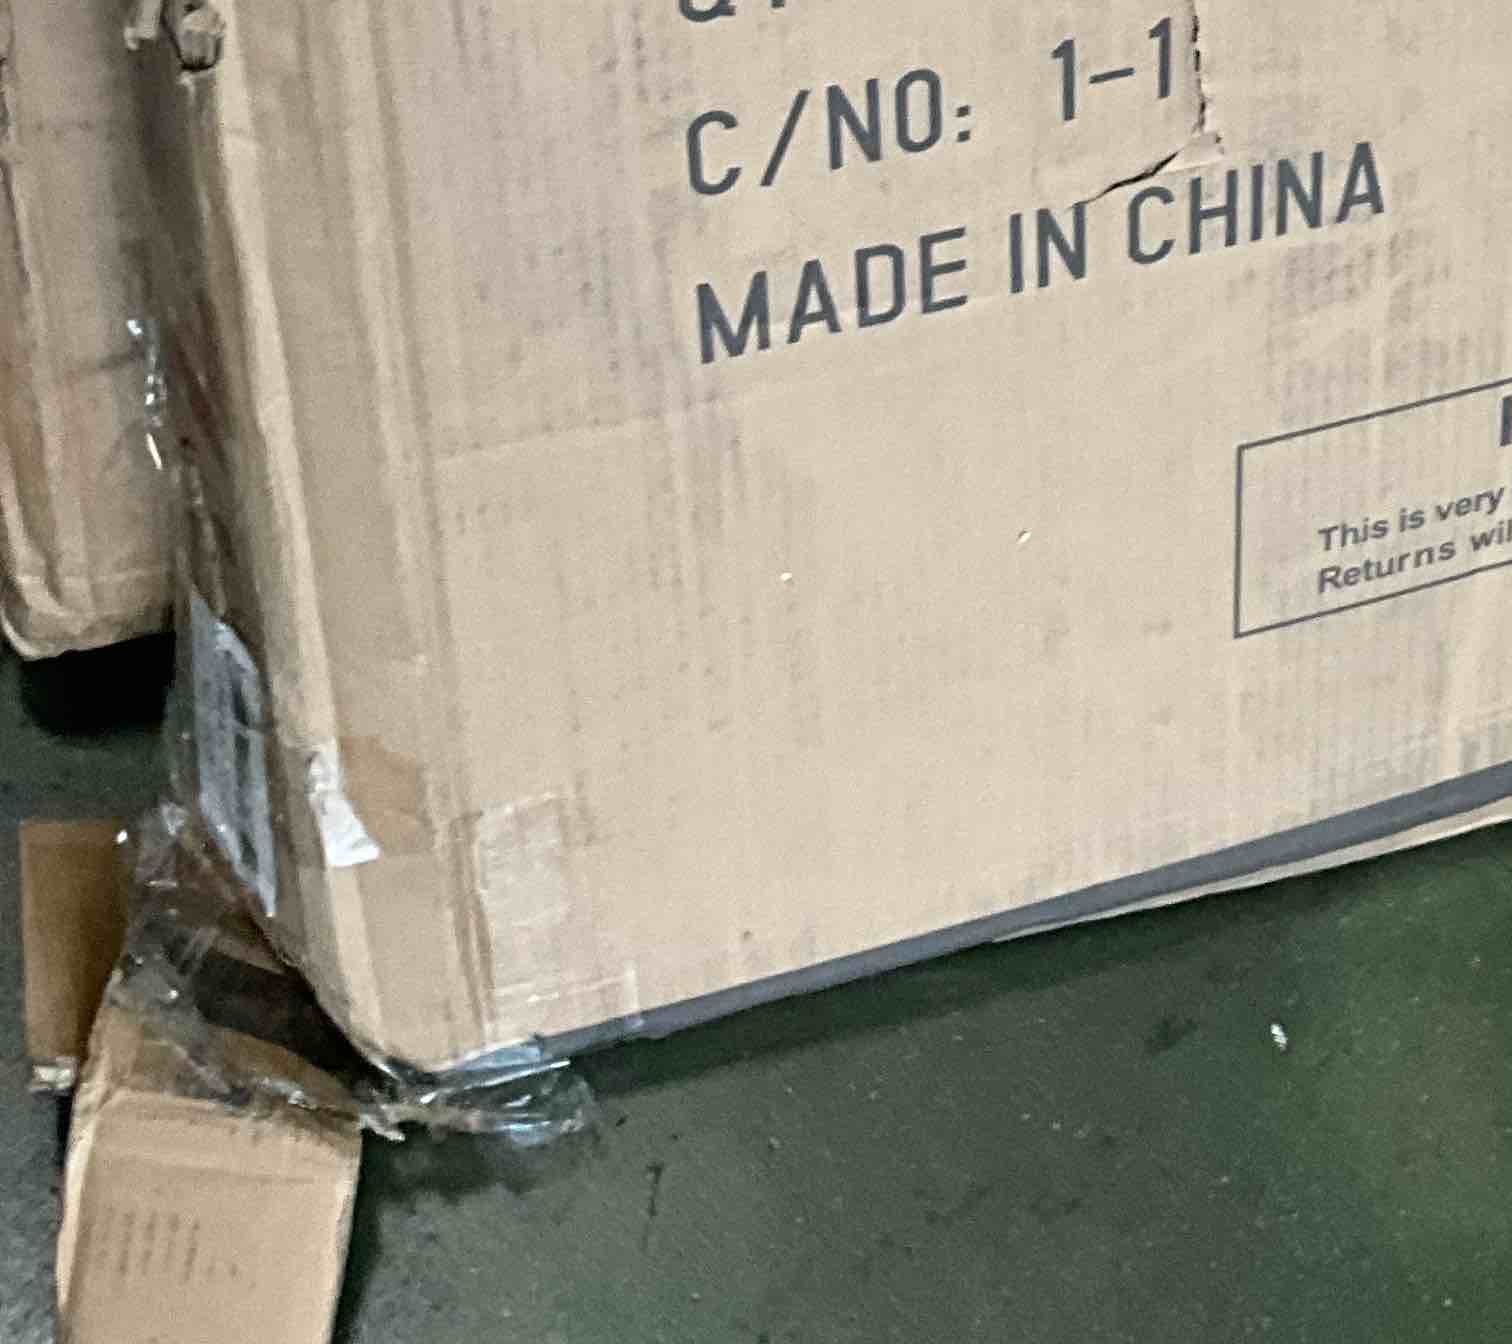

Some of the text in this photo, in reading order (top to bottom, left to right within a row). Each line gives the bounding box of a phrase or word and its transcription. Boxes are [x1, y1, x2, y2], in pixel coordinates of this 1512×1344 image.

[685, 16, 1174, 195] C/NO: 1-1
[696, 141, 1385, 365] MADE IN CHINA
[1318, 514, 1389, 553] This
[1399, 505, 1425, 533] is
[1434, 486, 1506, 524] very
[1318, 536, 1457, 595] Returns
